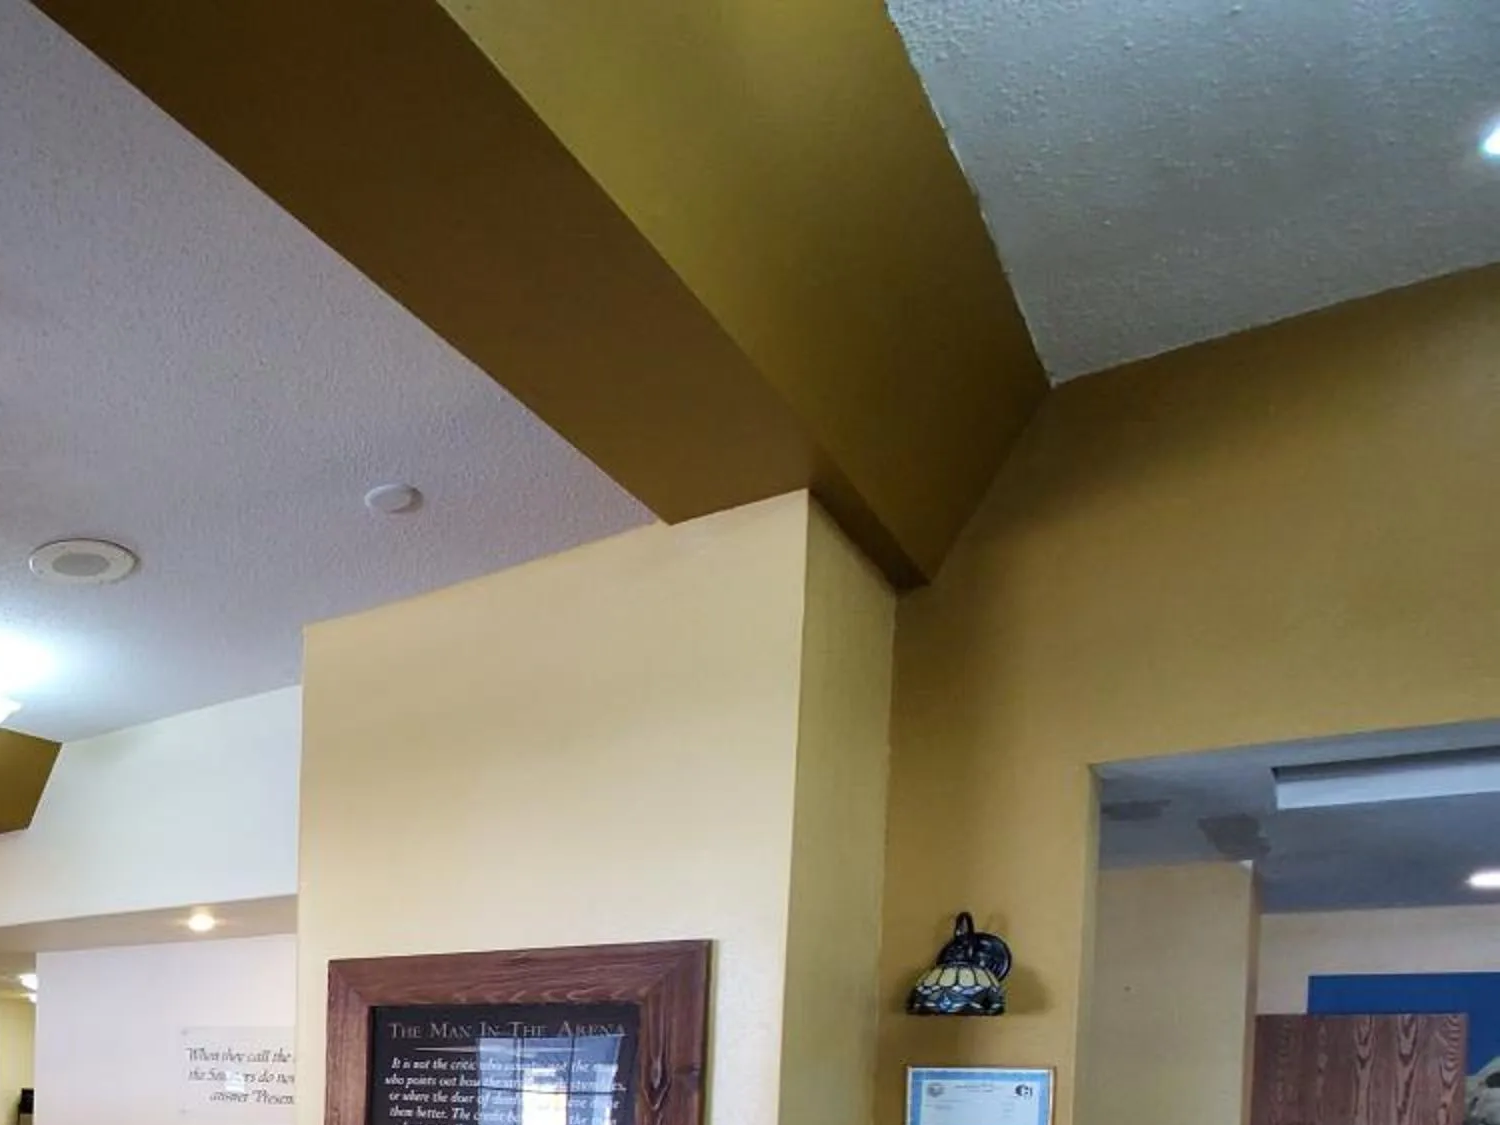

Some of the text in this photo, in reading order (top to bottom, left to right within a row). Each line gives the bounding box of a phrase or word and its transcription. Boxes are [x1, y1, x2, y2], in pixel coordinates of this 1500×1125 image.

[388, 1021, 421, 1039] THE
[430, 1022, 472, 1039] MAN
[507, 1021, 548, 1037] THE
[247, 1049, 270, 1063] call
[391, 1057, 401, 1070] It
[413, 1060, 431, 1070] not
[432, 1058, 448, 1070] the
[258, 1070, 274, 1083] do
[385, 1074, 405, 1086] who
[405, 1077, 437, 1089] points
[439, 1077, 457, 1087] out
[433, 1090, 449, 1103] the
[451, 1107, 471, 1120] The
